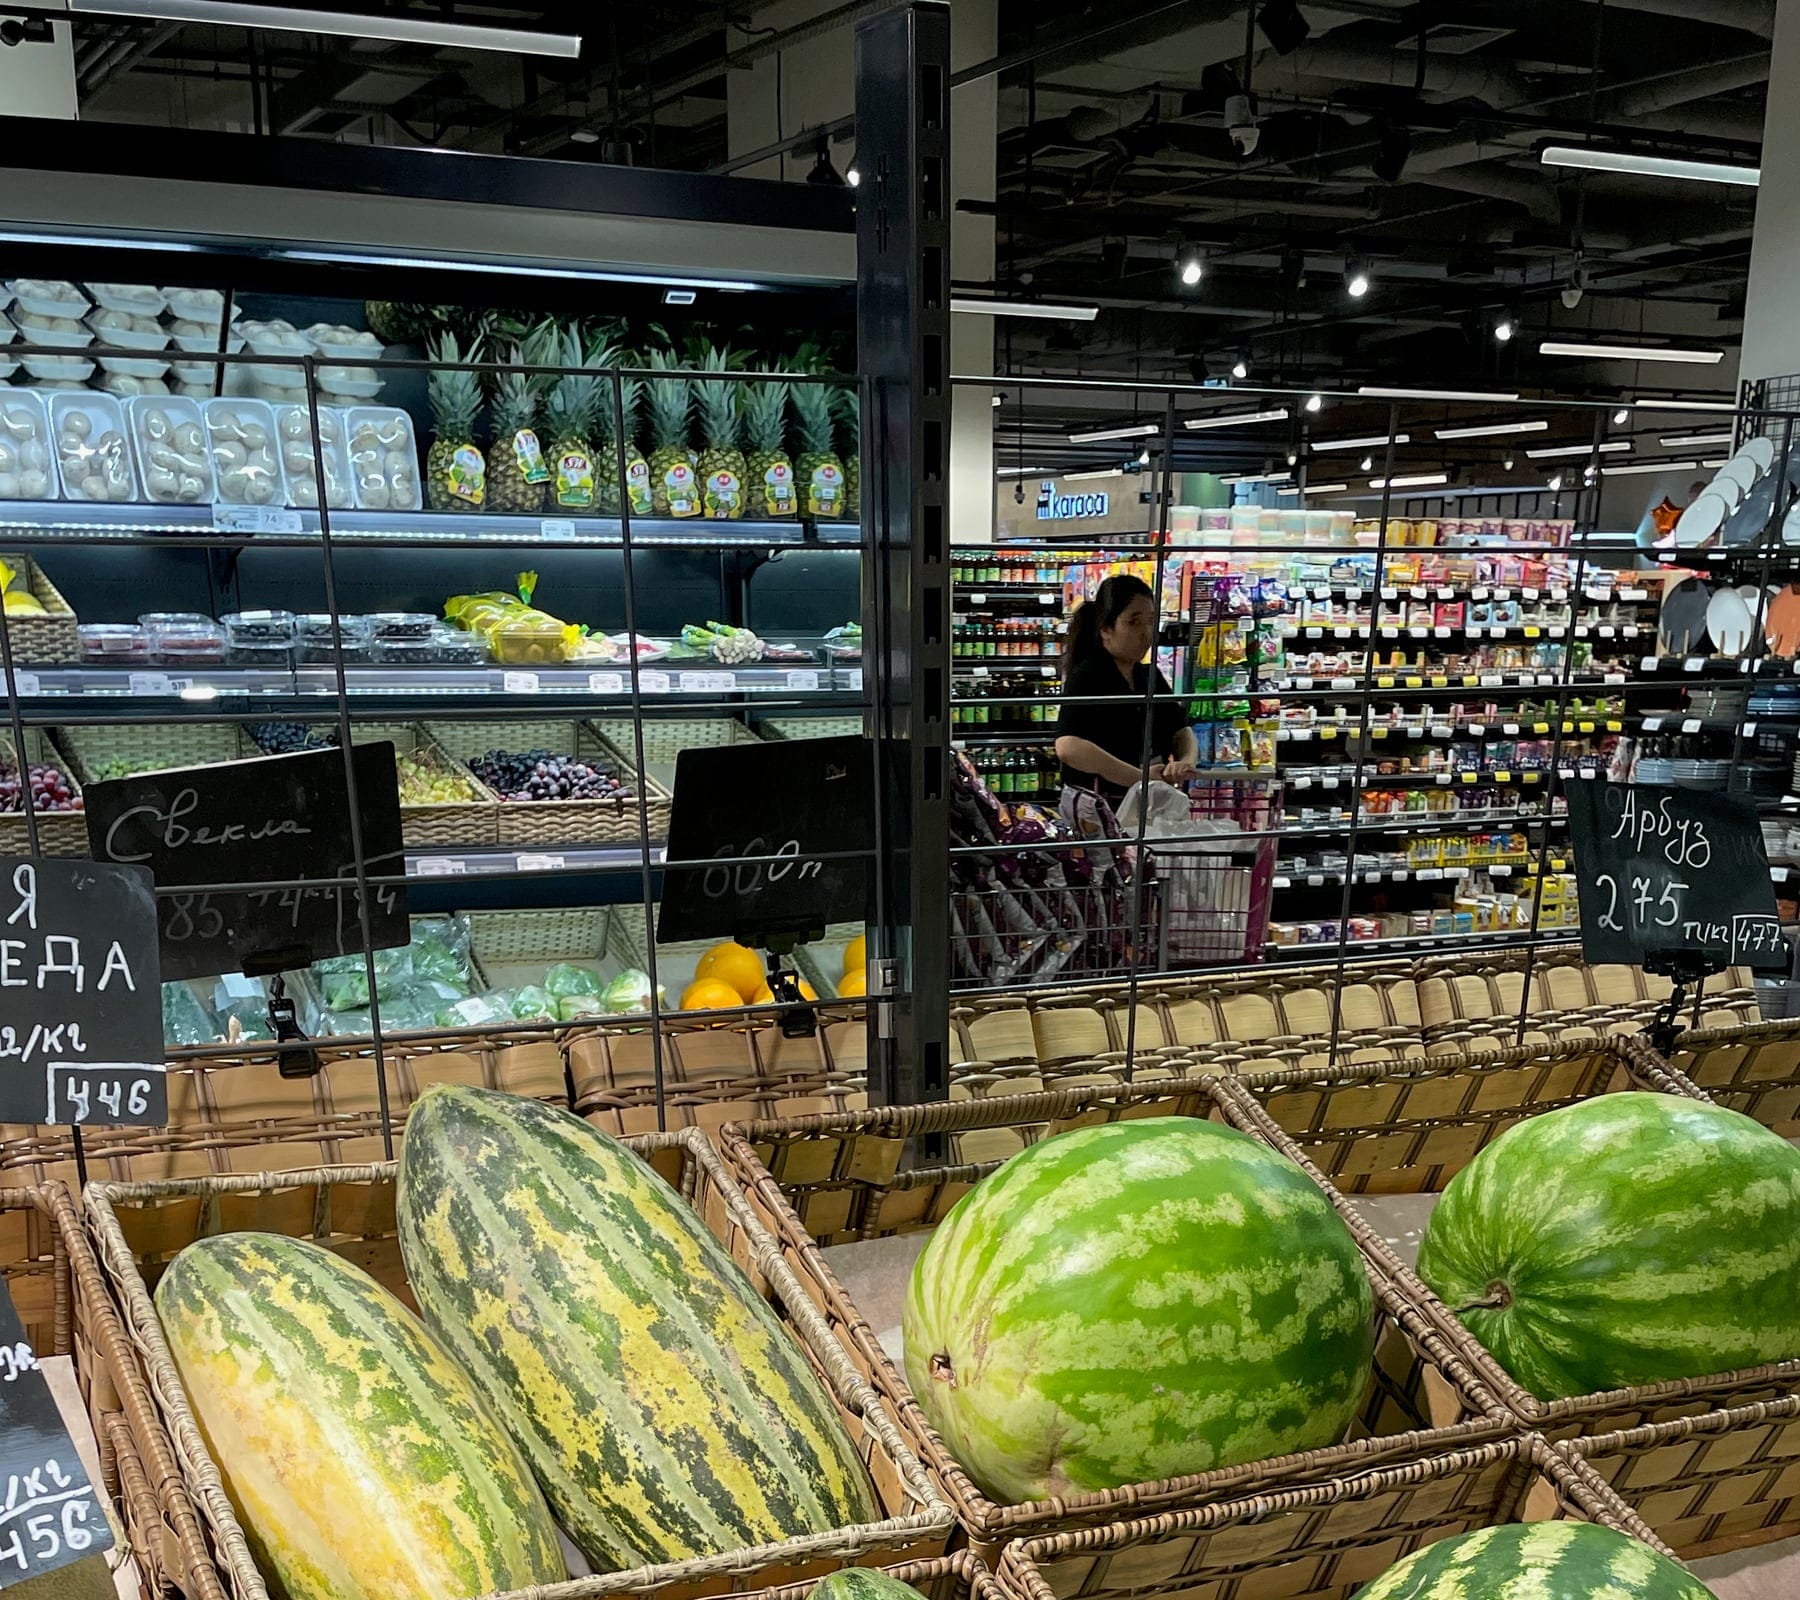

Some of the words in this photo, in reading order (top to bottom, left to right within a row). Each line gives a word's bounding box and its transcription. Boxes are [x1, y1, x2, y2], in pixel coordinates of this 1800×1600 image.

[106, 788, 311, 861] Свекла
[1611, 789, 1710, 868] Арбуз
[1596, 874, 1689, 932] 275
[1737, 919, 1780, 952] 477
